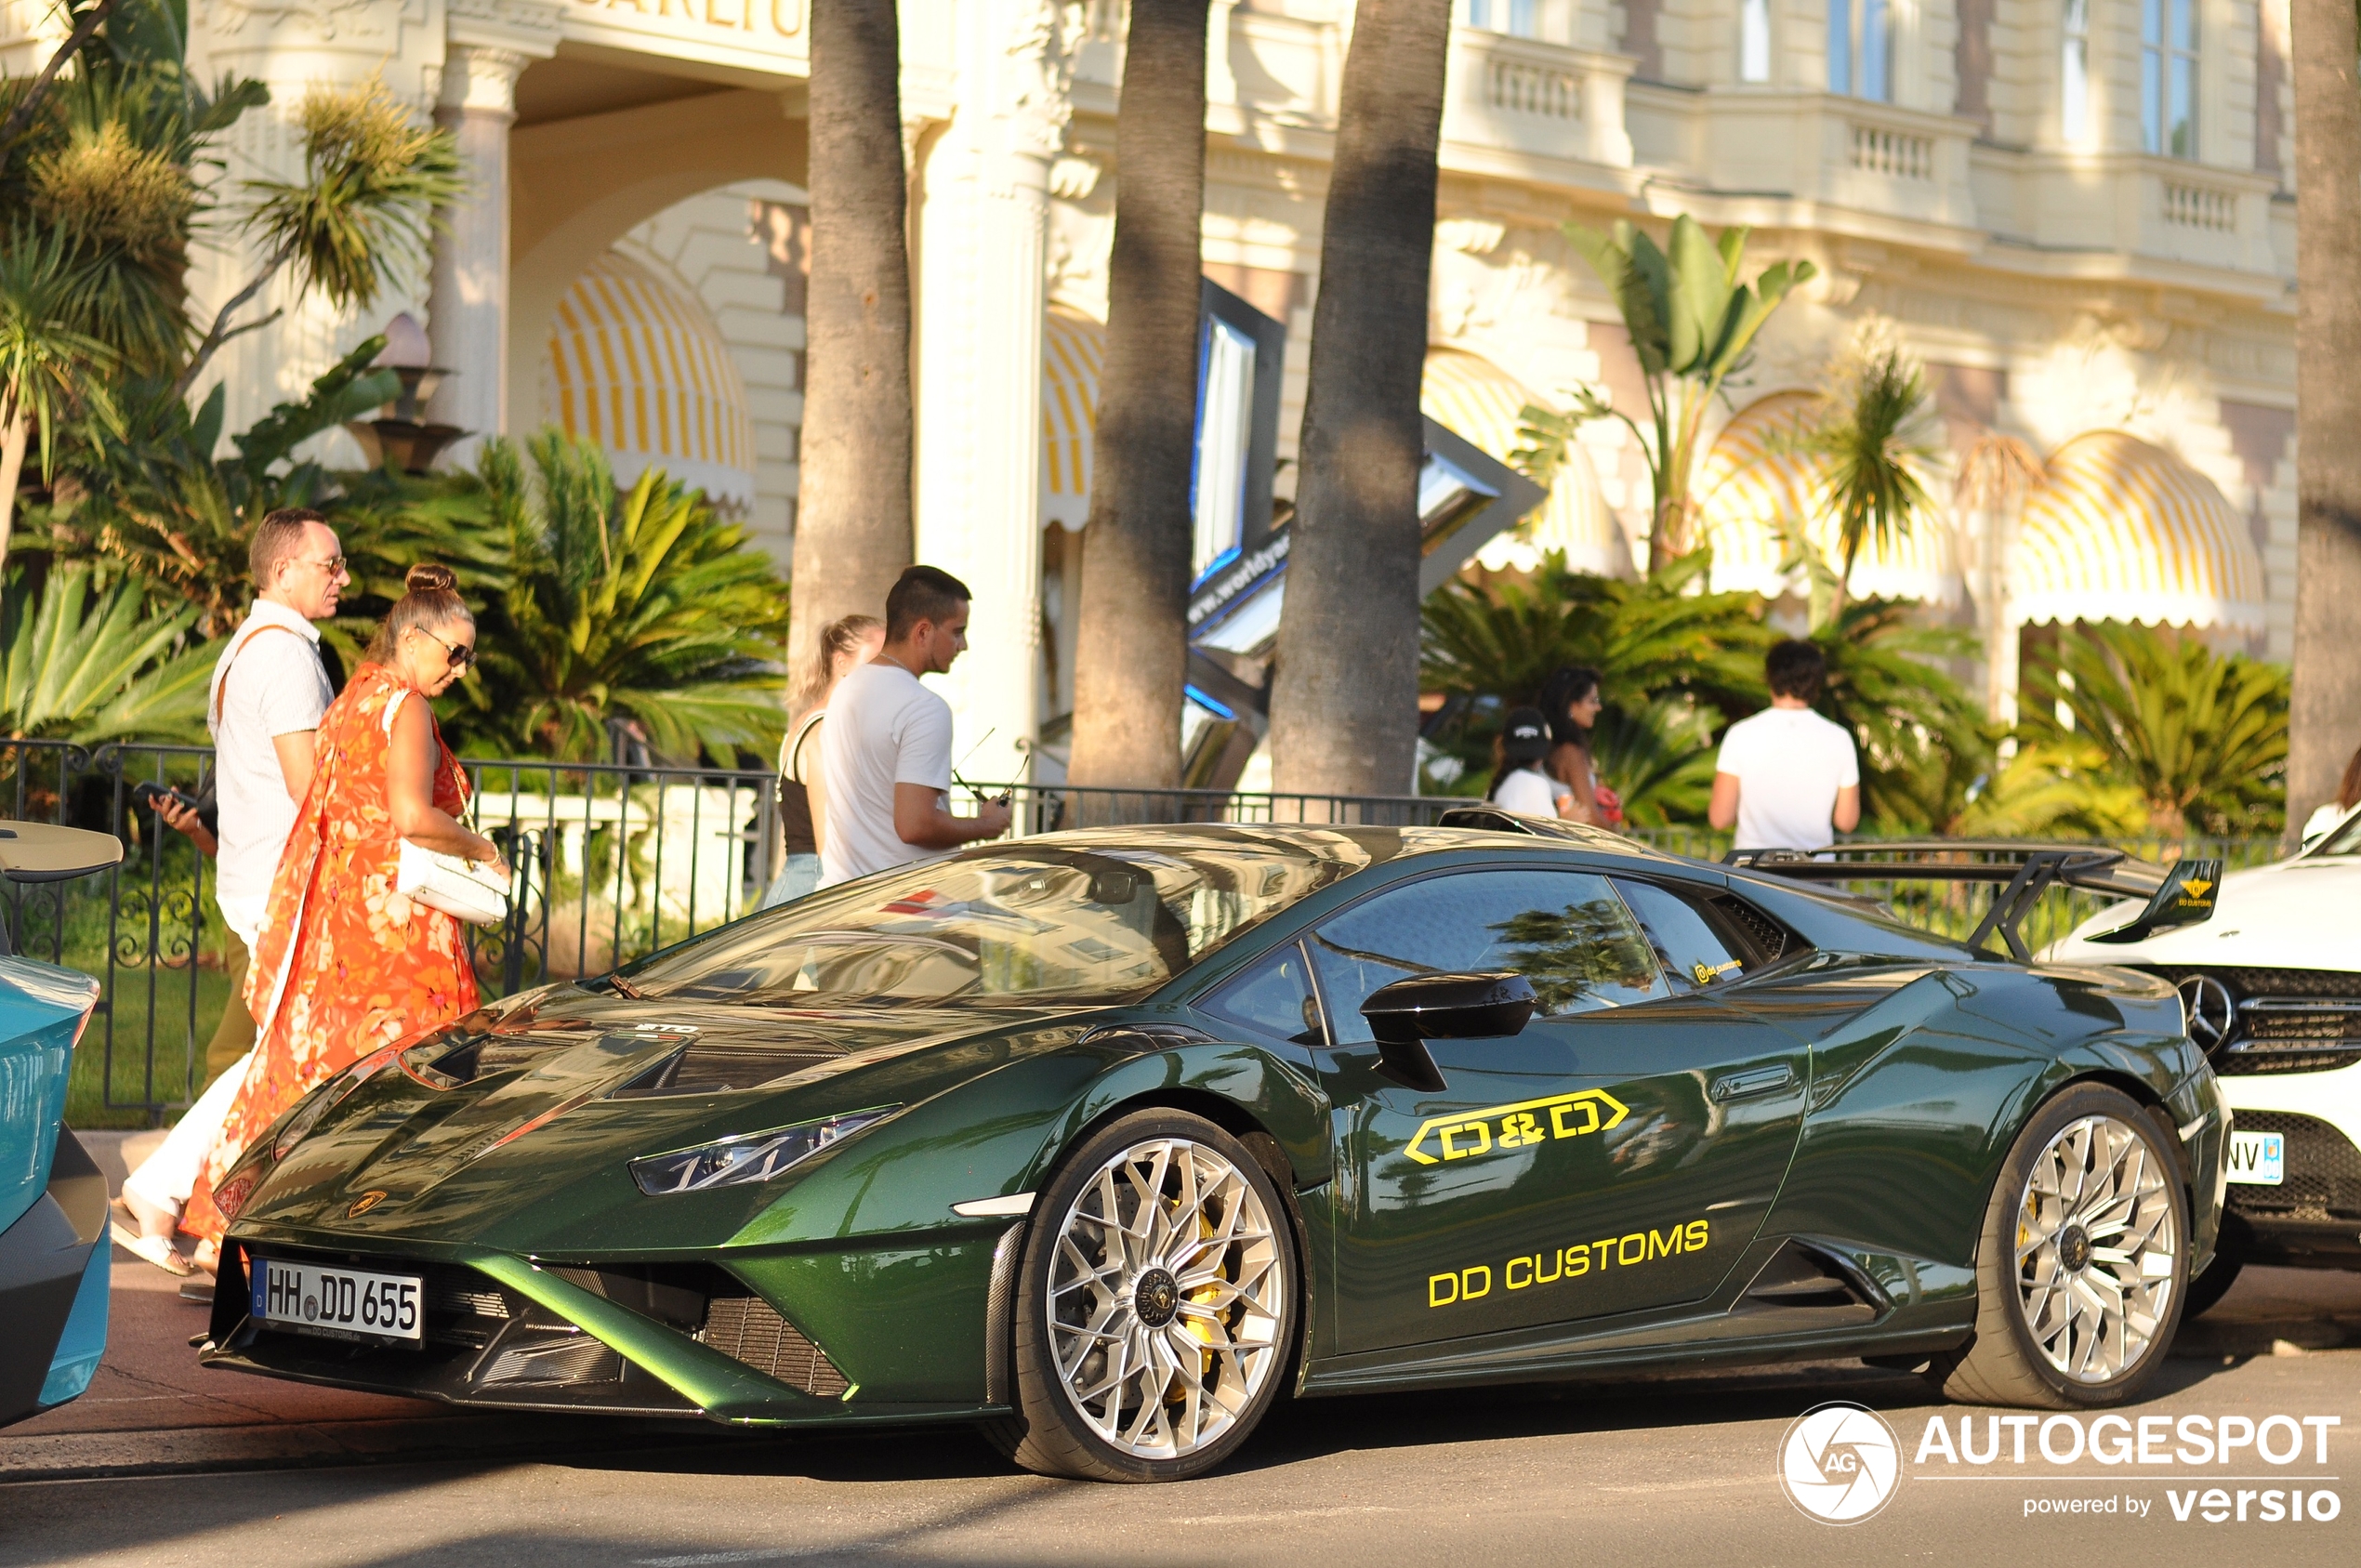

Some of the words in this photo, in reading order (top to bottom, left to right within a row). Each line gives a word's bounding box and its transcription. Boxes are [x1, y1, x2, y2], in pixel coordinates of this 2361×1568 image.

[634, 1023, 699, 1033] STO
[1429, 1265, 1491, 1308] DD
[1506, 1219, 1709, 1290] CUSTOMS
[256, 1295, 263, 1308] D
[268, 1268, 302, 1316] HH
[320, 1274, 356, 1323] DD
[362, 1280, 417, 1331] 655
